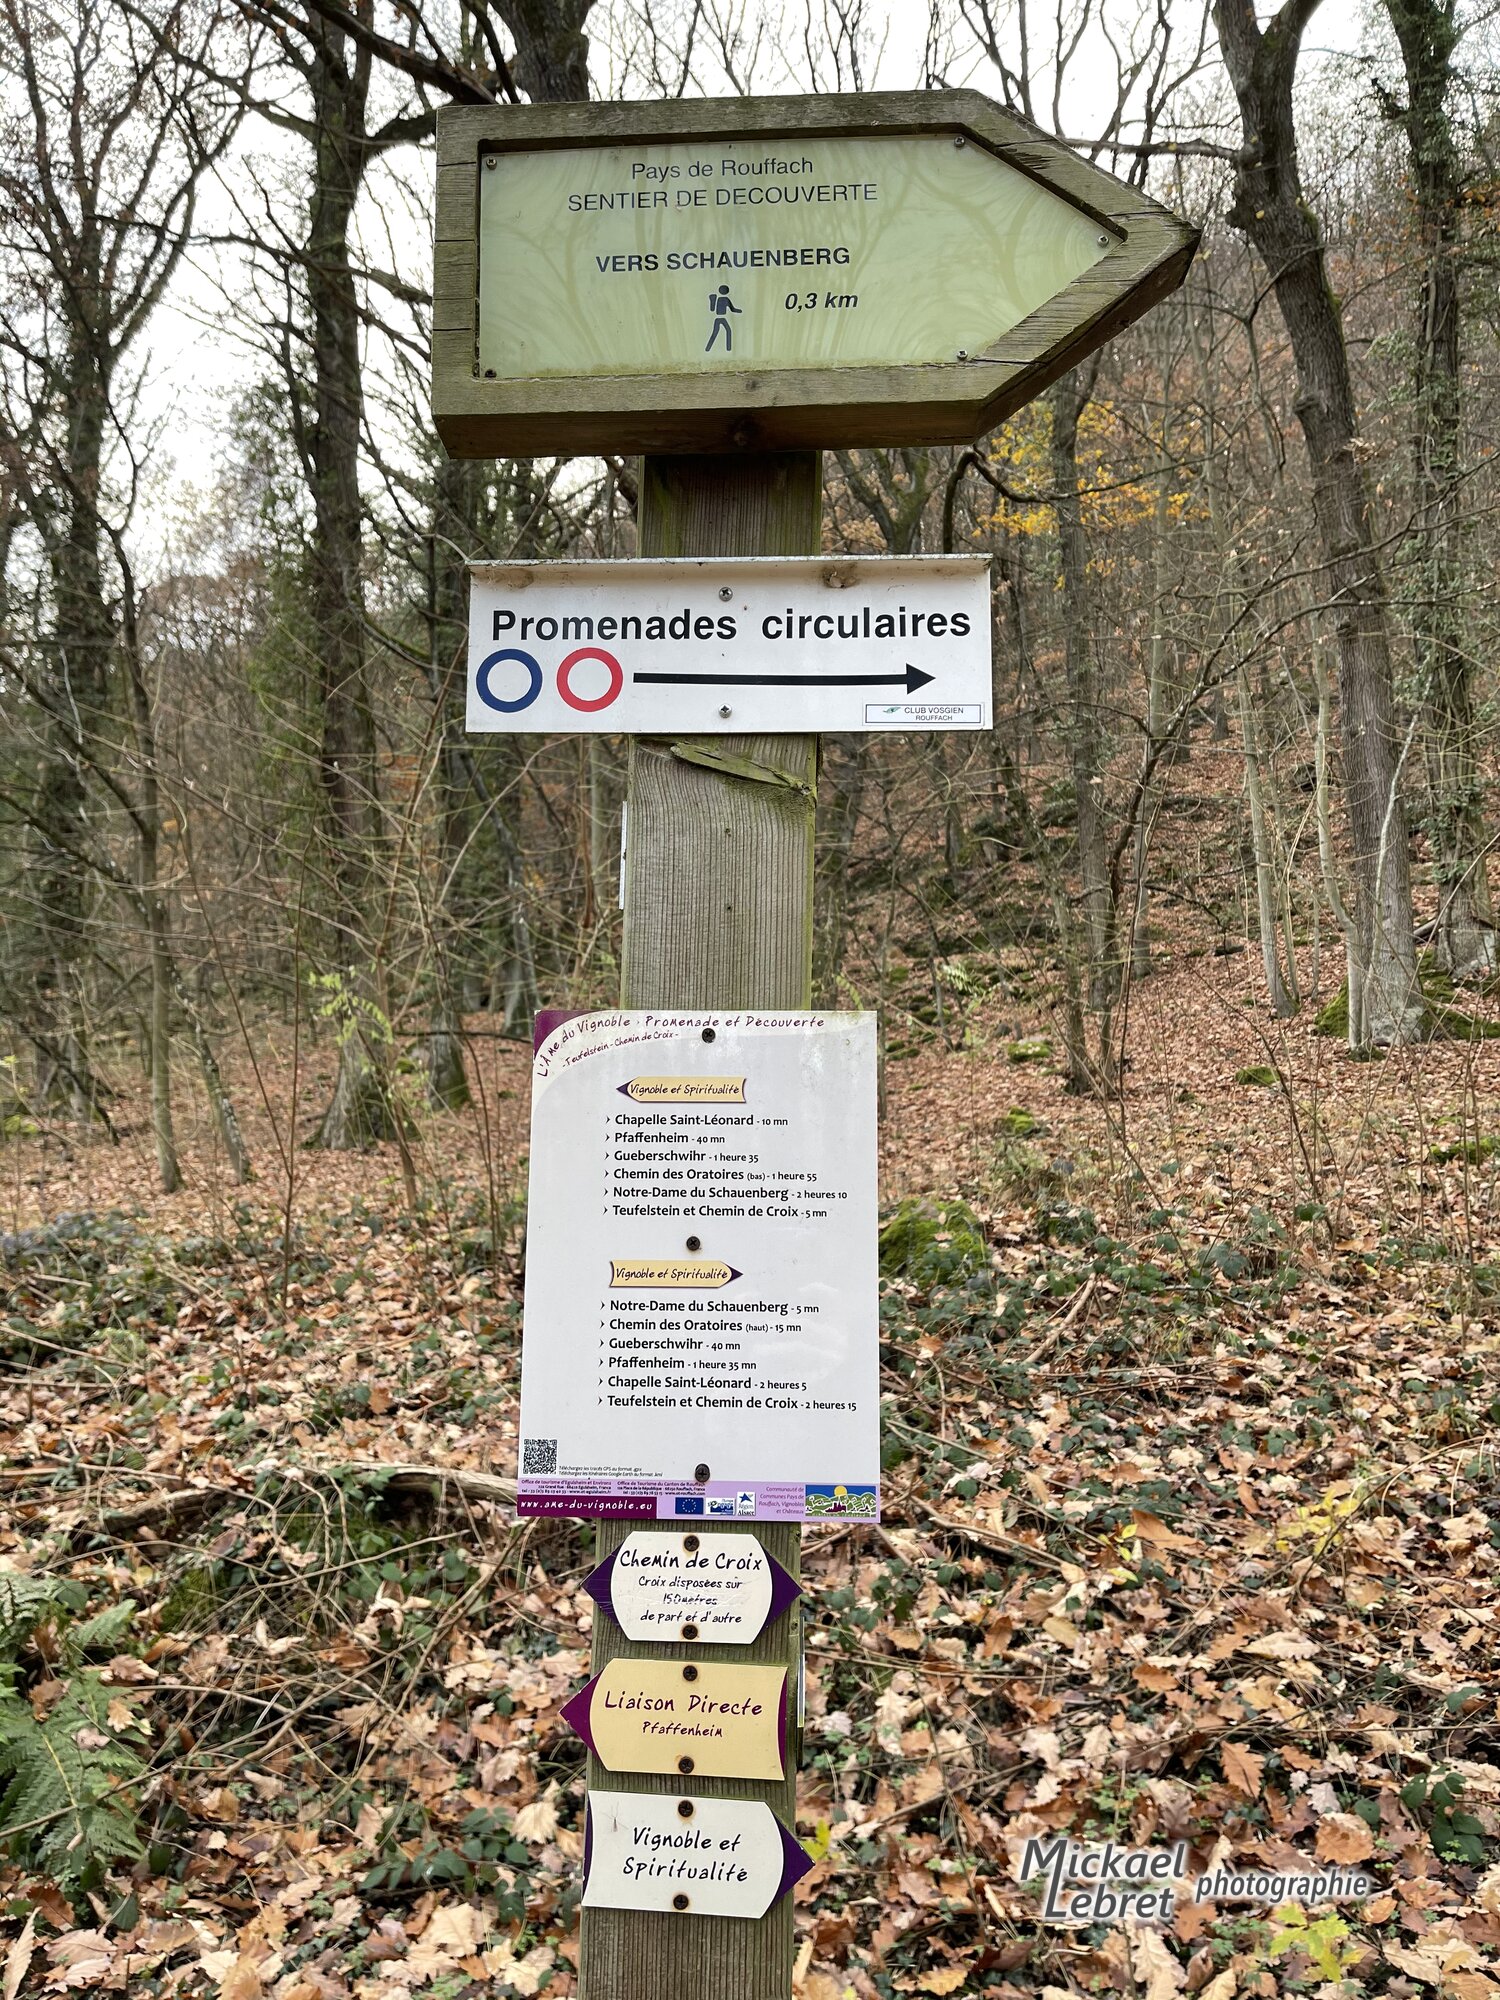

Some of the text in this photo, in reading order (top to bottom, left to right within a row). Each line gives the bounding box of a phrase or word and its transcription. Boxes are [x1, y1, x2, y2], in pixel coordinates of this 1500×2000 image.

[631, 157, 814, 183] Pays de Rouffach
[568, 183, 878, 212] SENTIER DE DECOUVERTE
[595, 247, 851, 274] VERS SCHAUENBERG
[784, 291, 859, 313] 0,3 km
[492, 606, 971, 641] Promenades circulaires
[562, 1029, 575, 1043] du
[577, 1015, 630, 1033] Vignoble
[645, 1015, 720, 1027] Promenade
[725, 1016, 740, 1027] et
[614, 1034, 640, 1047] Chemin
[641, 1032, 652, 1041] de
[653, 1030, 674, 1040] Croix
[630, 1083, 668, 1096] Vignoble
[671, 1084, 681, 1094] et
[615, 1114, 667, 1128] Chapelle
[669, 1114, 754, 1126] Saint-Léonard
[761, 1118, 771, 1126] 10
[614, 1132, 725, 1145] Pfaffenheim 40 mn
[614, 1150, 706, 1162] Gueberschwihr
[719, 1153, 747, 1162] heure
[748, 1154, 759, 1163] 35
[613, 1168, 660, 1180] Chemin
[662, 1168, 684, 1180] des
[686, 1169, 744, 1180] Oratoires
[747, 1172, 766, 1181] (bas)
[777, 1171, 805, 1180] heure
[807, 1173, 817, 1182] 55
[613, 1187, 847, 1201] Notre-Dame du Schauenberg 2 heures 10
[613, 1205, 680, 1217] Teufelstein
[683, 1207, 696, 1217] et
[699, 1205, 745, 1217] Chemin
[748, 1205, 763, 1217] de
[766, 1206, 798, 1217] Croix
[806, 1210, 811, 1219] 5
[616, 1268, 655, 1281] Vignoble
[657, 1268, 668, 1279] et
[610, 1301, 685, 1312] Notre-Dame
[688, 1301, 704, 1312] du
[707, 1301, 788, 1316] Schauenberg
[796, 1305, 801, 1314] 5
[609, 1319, 656, 1331] Chemin
[659, 1319, 681, 1331] des
[684, 1320, 743, 1331] Oratoires
[745, 1323, 769, 1333] (haut)
[775, 1324, 784, 1333] 15
[609, 1338, 741, 1352] Gueberschwihr 40 mn
[608, 1357, 685, 1369] Pfaffenheim
[698, 1360, 727, 1369] heure
[728, 1361, 739, 1371] 35
[608, 1376, 662, 1390] Chapelle
[665, 1377, 752, 1389] Saint-Léonard
[767, 1380, 800, 1390] heures
[801, 1382, 807, 1391] 5
[607, 1395, 676, 1407] Teufelstein
[679, 1397, 693, 1407] et
[696, 1396, 743, 1408] Chemin
[746, 1396, 762, 1408] de
[765, 1397, 798, 1409] Croix
[813, 1401, 846, 1410] heures
[848, 1402, 857, 1411] 15
[620, 1549, 763, 1571] Chemin de Croix
[638, 1576, 666, 1587] Croix
[640, 1610, 655, 1621] de
[657, 1611, 682, 1624] part
[685, 1611, 697, 1622] et
[604, 1691, 763, 1715] Liaison Directe
[642, 1722, 723, 1737] Pfaffenheim
[633, 1827, 741, 1851] Vignoble et
[623, 1857, 748, 1882] Spiritualité
